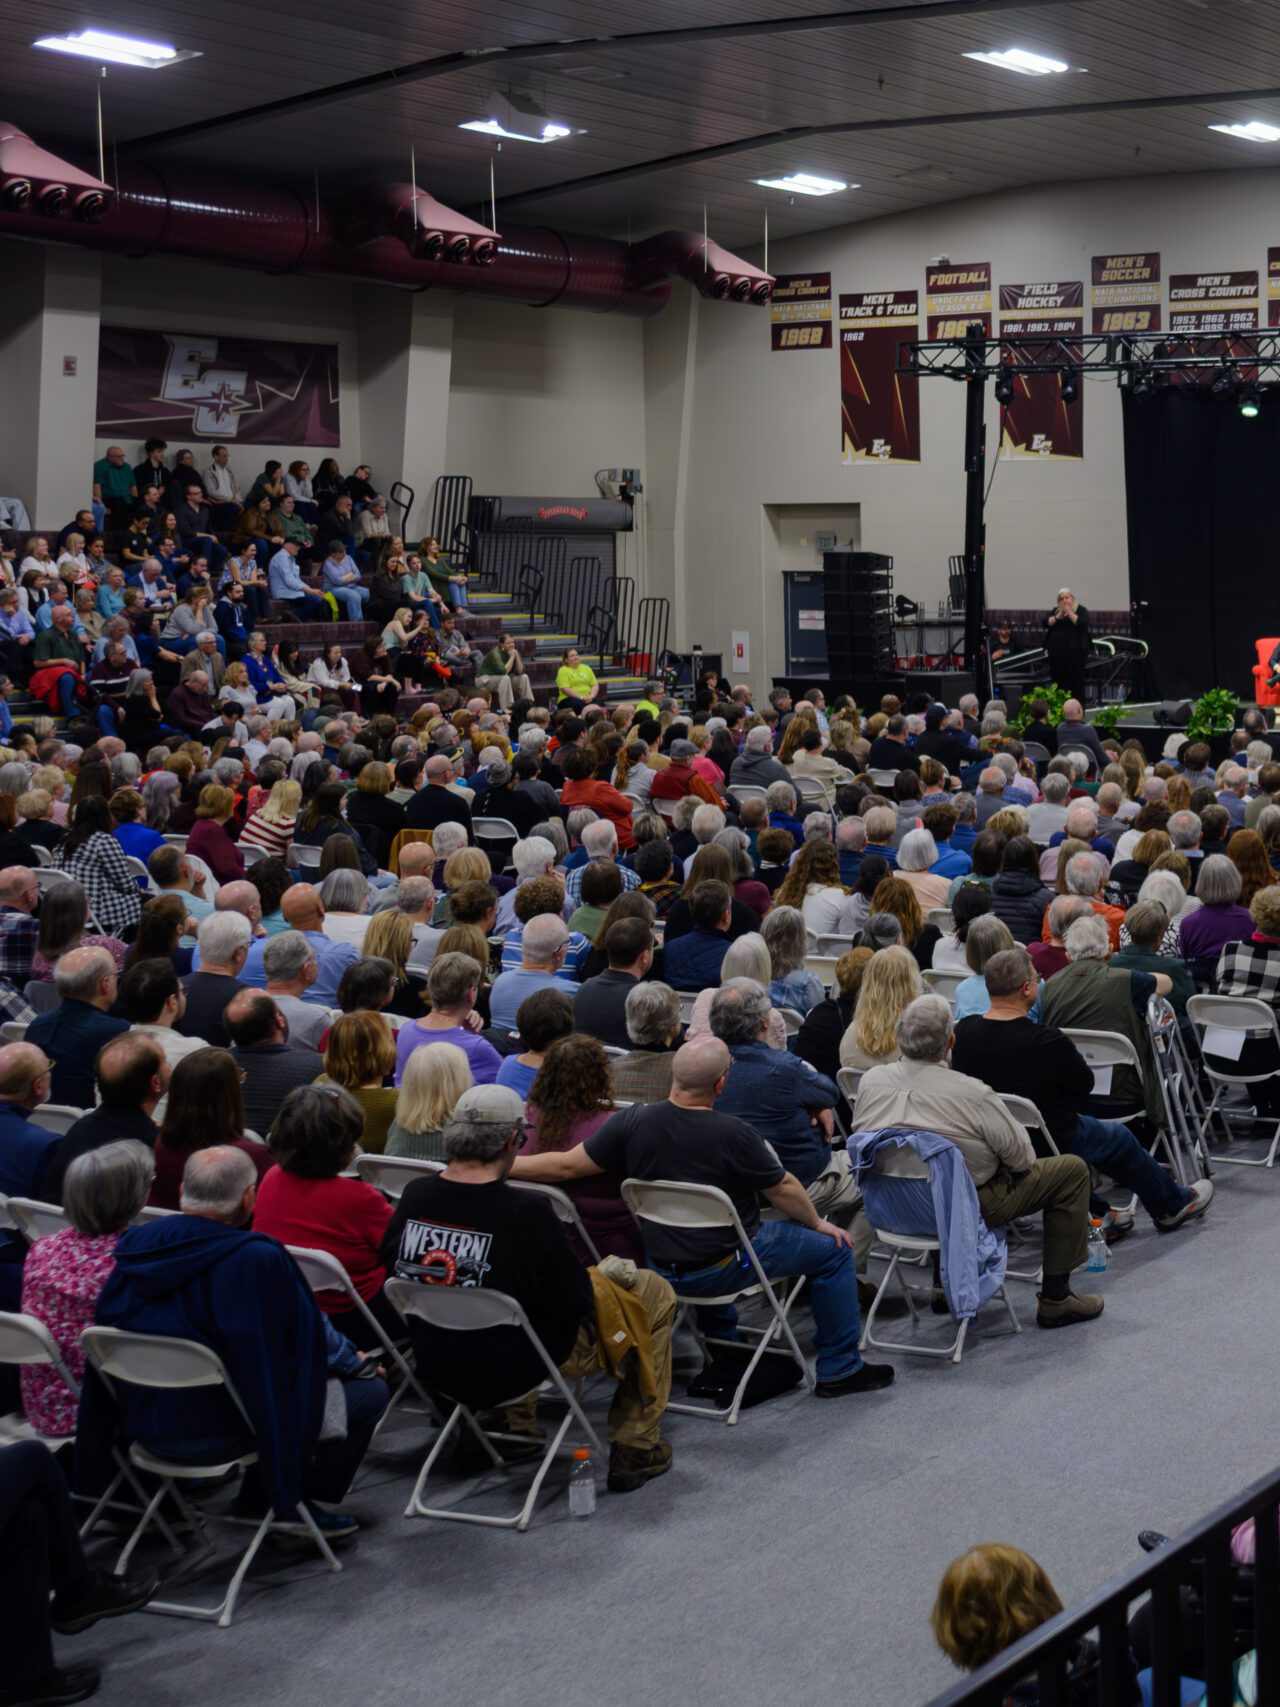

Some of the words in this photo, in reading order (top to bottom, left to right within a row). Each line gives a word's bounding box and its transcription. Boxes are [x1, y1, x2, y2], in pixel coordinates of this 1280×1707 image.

[1106, 256, 1146, 269] MEN'S
[929, 271, 989, 287] FOOTBALL
[1101, 267, 1151, 282] SOCCER
[1196, 275, 1231, 287] MEN'S
[1023, 284, 1059, 296] FIELD
[1095, 287, 1114, 297] NAIA
[1117, 285, 1158, 295] NATIONAL
[1170, 287, 1206, 299] CROSS
[1208, 285, 1258, 297] COUNTRY
[862, 293, 895, 306] MEN'S
[1017, 296, 1065, 309] HOCKEY
[841, 306, 874, 318] TRACK
[886, 303, 918, 315] FIELD
[1053, 321, 1076, 332] 1984
[1102, 311, 1151, 332] 1963
[780, 327, 824, 347] 1968
[844, 331, 865, 342] 1962
[403, 1223, 487, 1262] WESTERN
